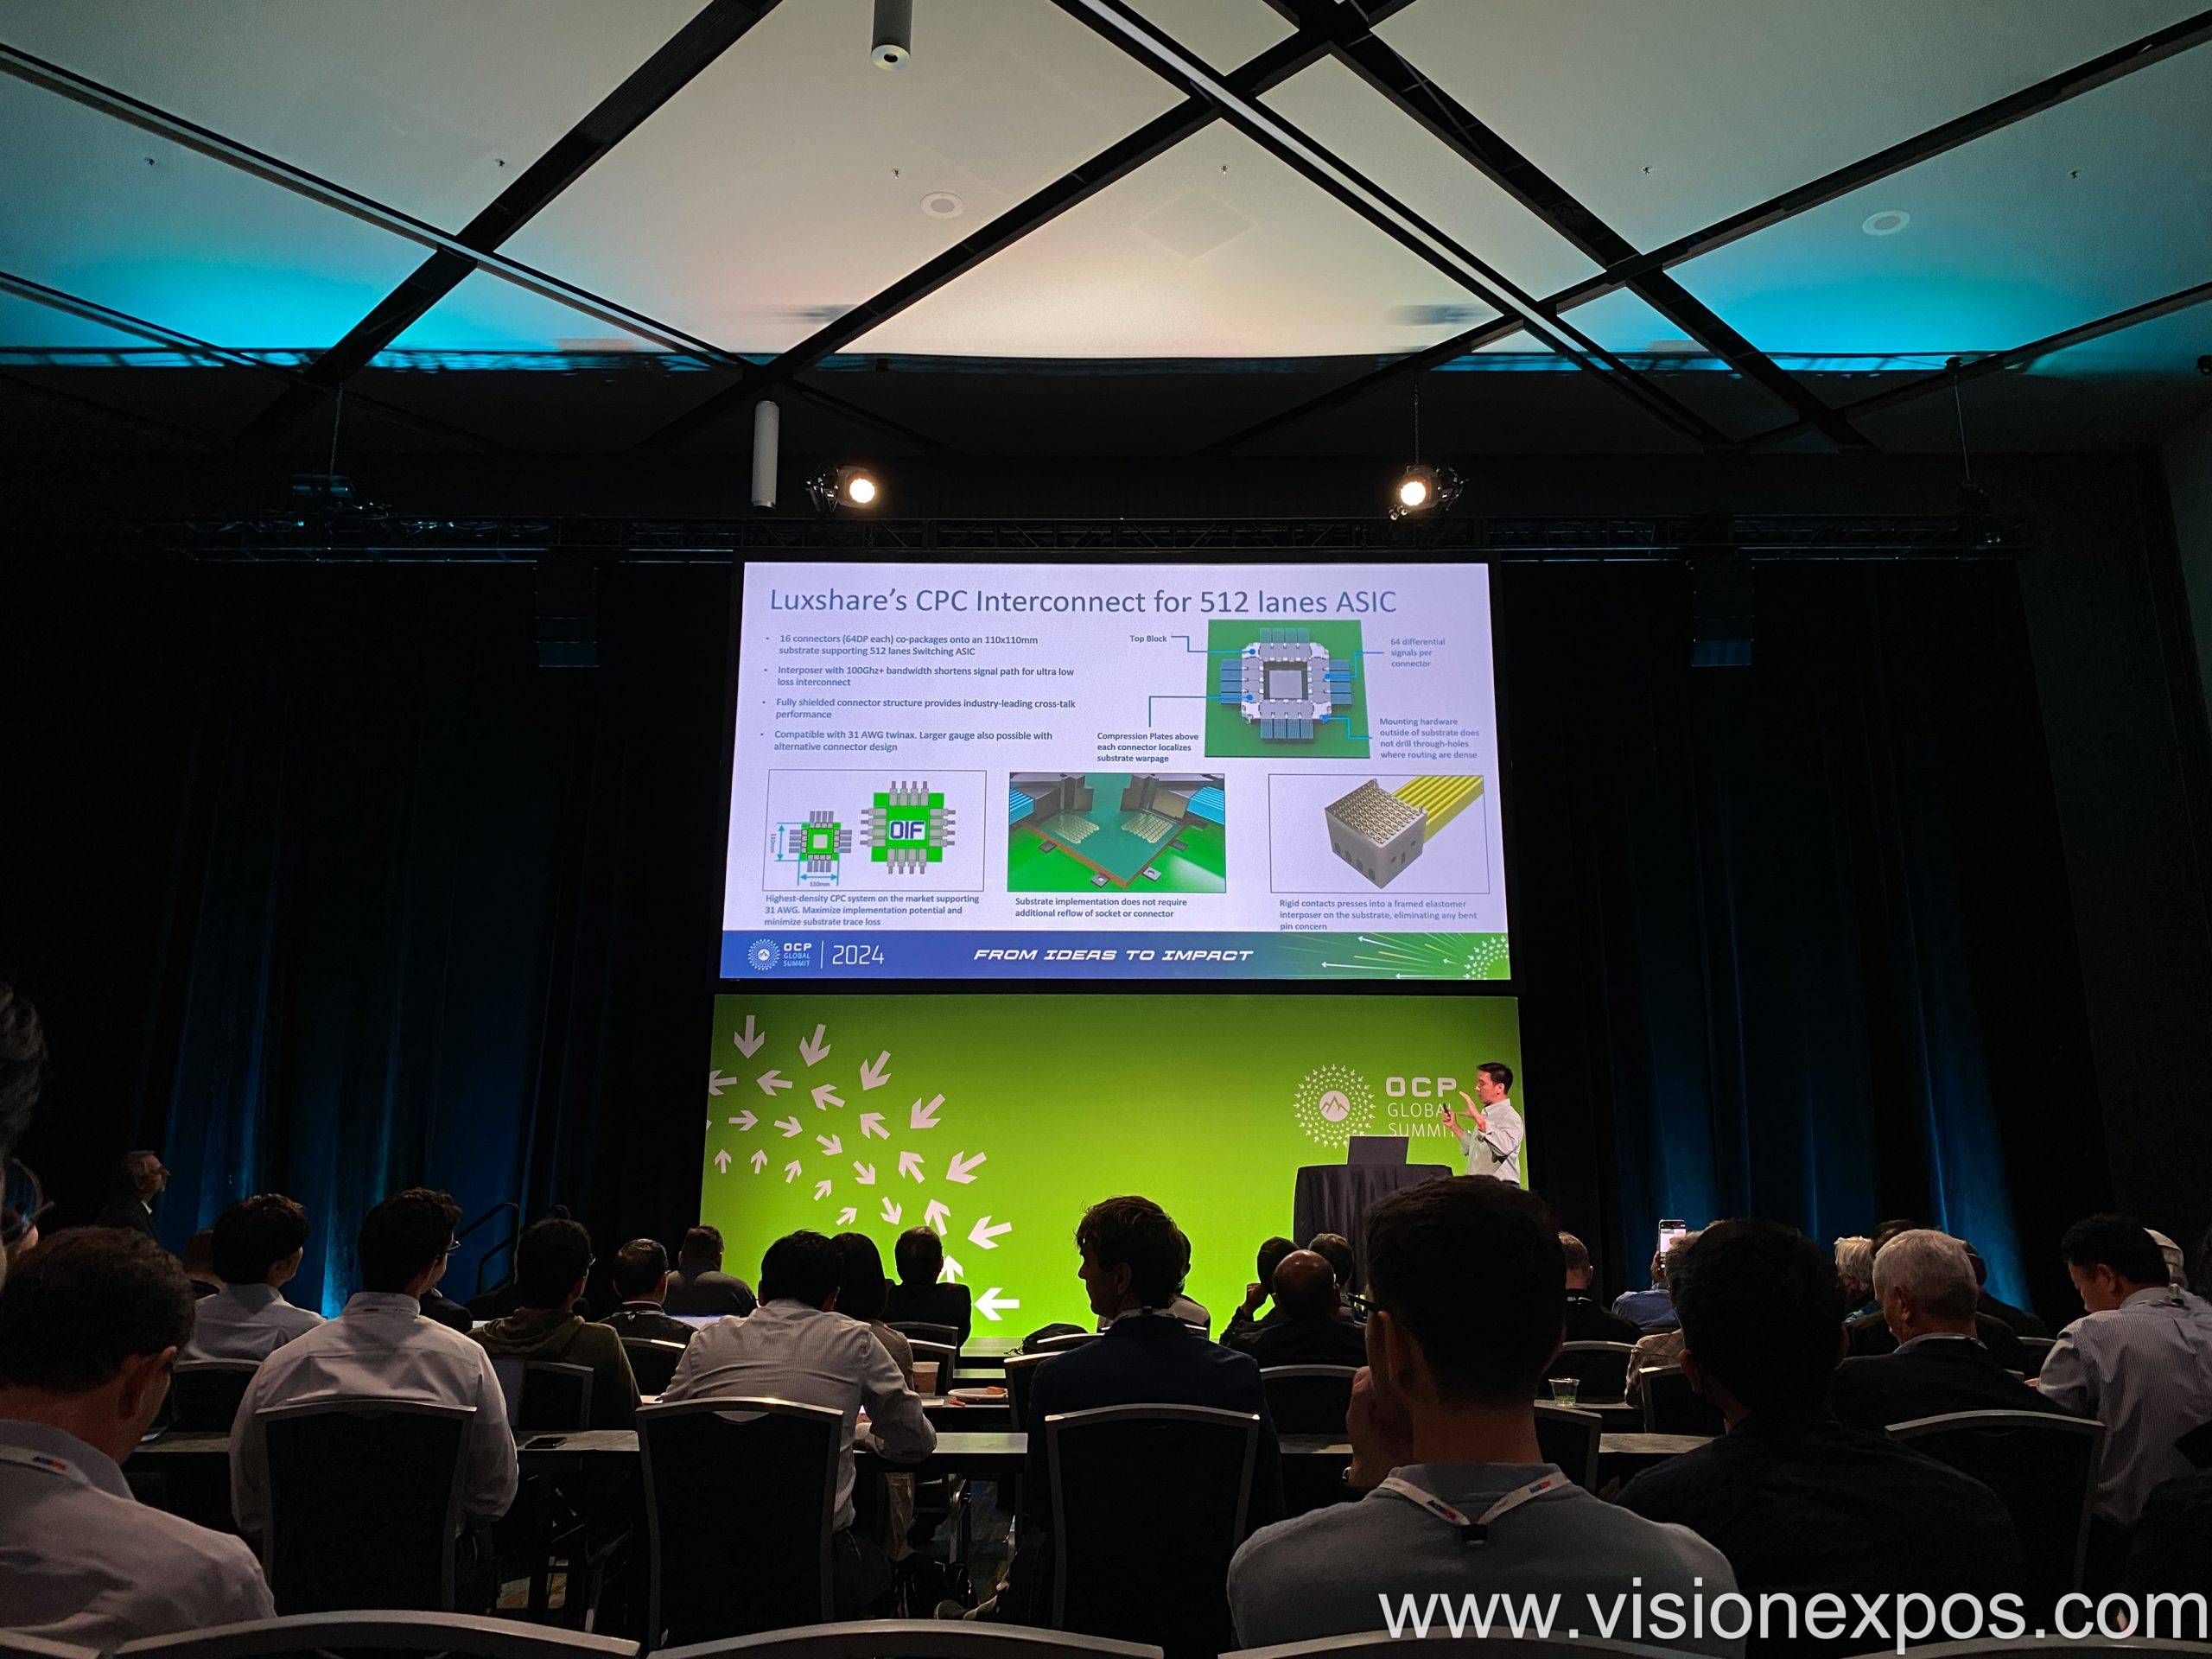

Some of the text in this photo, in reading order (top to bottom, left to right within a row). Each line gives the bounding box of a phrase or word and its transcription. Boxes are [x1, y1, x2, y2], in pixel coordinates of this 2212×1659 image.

[916, 589, 968, 612] CPC
[977, 590, 1146, 613] Interconnect
[1153, 589, 1192, 613] for
[1200, 591, 1249, 613] 512
[1258, 589, 1327, 613] lanes
[1336, 590, 1396, 613] ASIC
[869, 634, 894, 645] each)
[895, 635, 948, 645] co-packages
[1129, 634, 1145, 643] Top
[1402, 637, 1446, 645] differential
[779, 645, 976, 658] substrate supporting 512 lanes Switching ASIC
[1390, 648, 1418, 658] signals
[778, 665, 1075, 677] Interposer with 100Ghz+ bandwidth shortens signal path for ultra low
[777, 677, 851, 686] loss interconnect
[776, 697, 798, 708] Fully
[798, 697, 836, 706] shielded
[836, 698, 881, 707] connector
[924, 698, 962, 709] provides
[963, 699, 1033, 709] industry-leading
[1034, 699, 1076, 708] cross-talk
[775, 709, 832, 720] performance
[1379, 717, 1419, 727] Mounting
[774, 729, 1052, 741] Compatible with 31 AWG twinax. Larger gauge also possible with
[1096, 732, 1148, 741] Compression
[1174, 732, 1199, 741] above
[1421, 728, 1459, 737] substrate
[1459, 728, 1480, 737] does
[773, 741, 821, 751] alternative
[869, 742, 898, 753] design
[1158, 743, 1192, 752] localizes
[1395, 739, 1412, 747] drill
[1413, 739, 1469, 749] through-holes
[1096, 753, 1134, 762] substrate
[1380, 750, 1406, 759] where
[1408, 751, 1437, 760] routing
[1453, 750, 1478, 759] dense
[890, 821, 925, 840] OIF
[766, 893, 829, 904] Highest-density
[830, 893, 847, 902] CPC
[847, 895, 876, 904] system
[890, 893, 904, 902] the
[936, 894, 980, 904] supporting
[1014, 897, 1054, 906] Substrate
[1055, 897, 1120, 907] implementation
[1158, 898, 1187, 907] require
[1279, 899, 1300, 908] Rigid
[1394, 899, 1424, 908] framed
[1425, 899, 1467, 908] elastomer
[765, 906, 963, 916] 31 AWG. Maximize implementation potential and
[1014, 908, 1056, 917] additional
[1057, 908, 1084, 917] reflow
[1084, 908, 1094, 917] of
[1095, 909, 1122, 918] socket
[1280, 911, 1322, 920] interposer
[1351, 911, 1392, 920] substrate,
[1394, 911, 1440, 920] eliminating
[1441, 912, 1457, 921] any
[1458, 911, 1478, 919] bent
[803, 917, 842, 925] substrate
[1279, 921, 1328, 932] pin concern
[783, 943, 812, 951] OCP
[832, 944, 885, 964] 2024
[973, 950, 1254, 961] FROM IDEAS TO IMPACT
[1385, 1077, 1457, 1097] OCP
